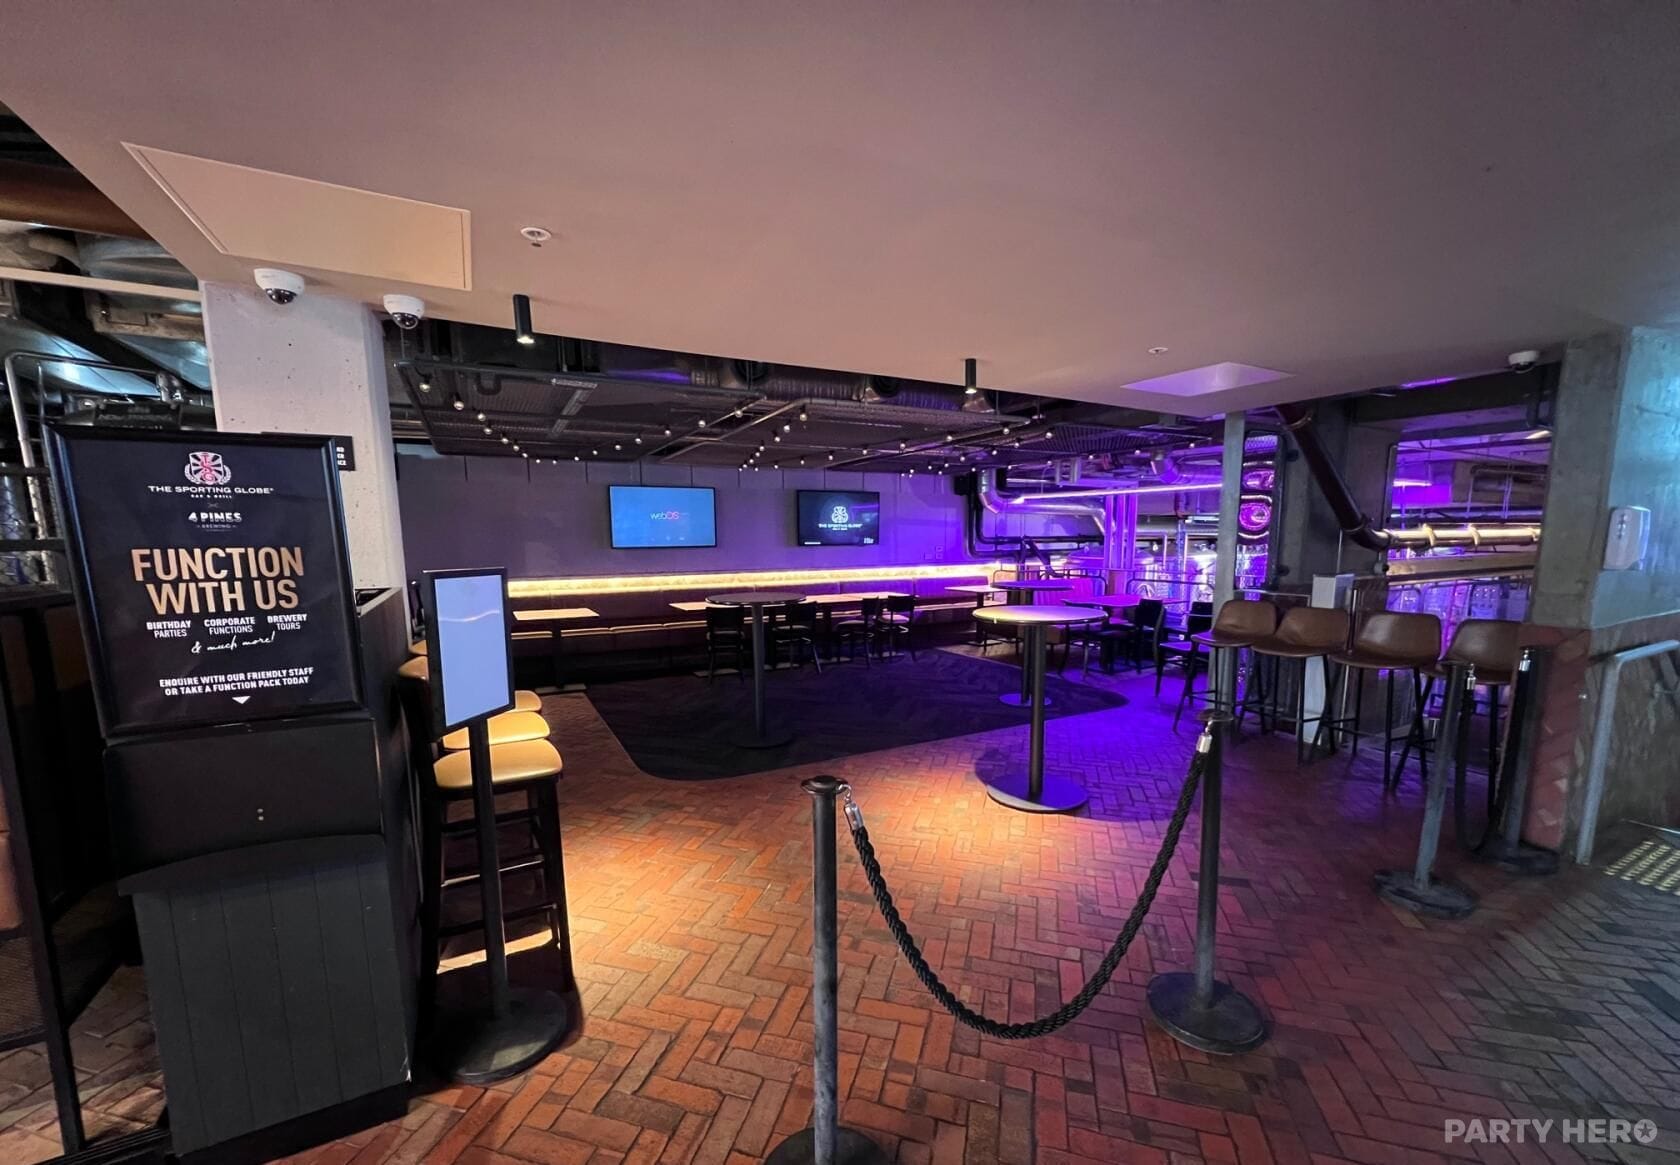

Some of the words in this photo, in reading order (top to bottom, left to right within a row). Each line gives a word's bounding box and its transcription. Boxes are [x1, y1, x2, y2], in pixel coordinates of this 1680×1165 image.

[148, 485, 172, 493] THE
[175, 486, 232, 494] SPORTING
[188, 512, 198, 523] 4
[200, 512, 242, 523] PINES
[650, 511, 680, 520] webOS
[131, 547, 304, 581] FUNCTION
[146, 581, 246, 615] WITH
[254, 579, 299, 610] US
[204, 617, 256, 627] CORPORATE
[267, 614, 307, 623] BREWERY
[146, 620, 191, 630] BIRTHDAY
[209, 625, 253, 635] FUNCTIONS
[276, 622, 301, 630] TOURS
[154, 629, 187, 638] PARTIES
[191, 641, 202, 653] &
[207, 635, 238, 651] much
[242, 630, 276, 646] more!
[159, 677, 199, 688] ENQUIRE
[200, 675, 225, 685] WITH
[227, 673, 246, 682] OUR
[247, 669, 287, 681] FRIENDLY
[288, 667, 314, 677] STAFF
[165, 687, 179, 696] OR
[180, 685, 203, 694] TAKE
[205, 684, 212, 693] A
[213, 680, 257, 692] FUNCTION
[258, 678, 281, 688] PACK
[283, 676, 309, 686] TODAY
